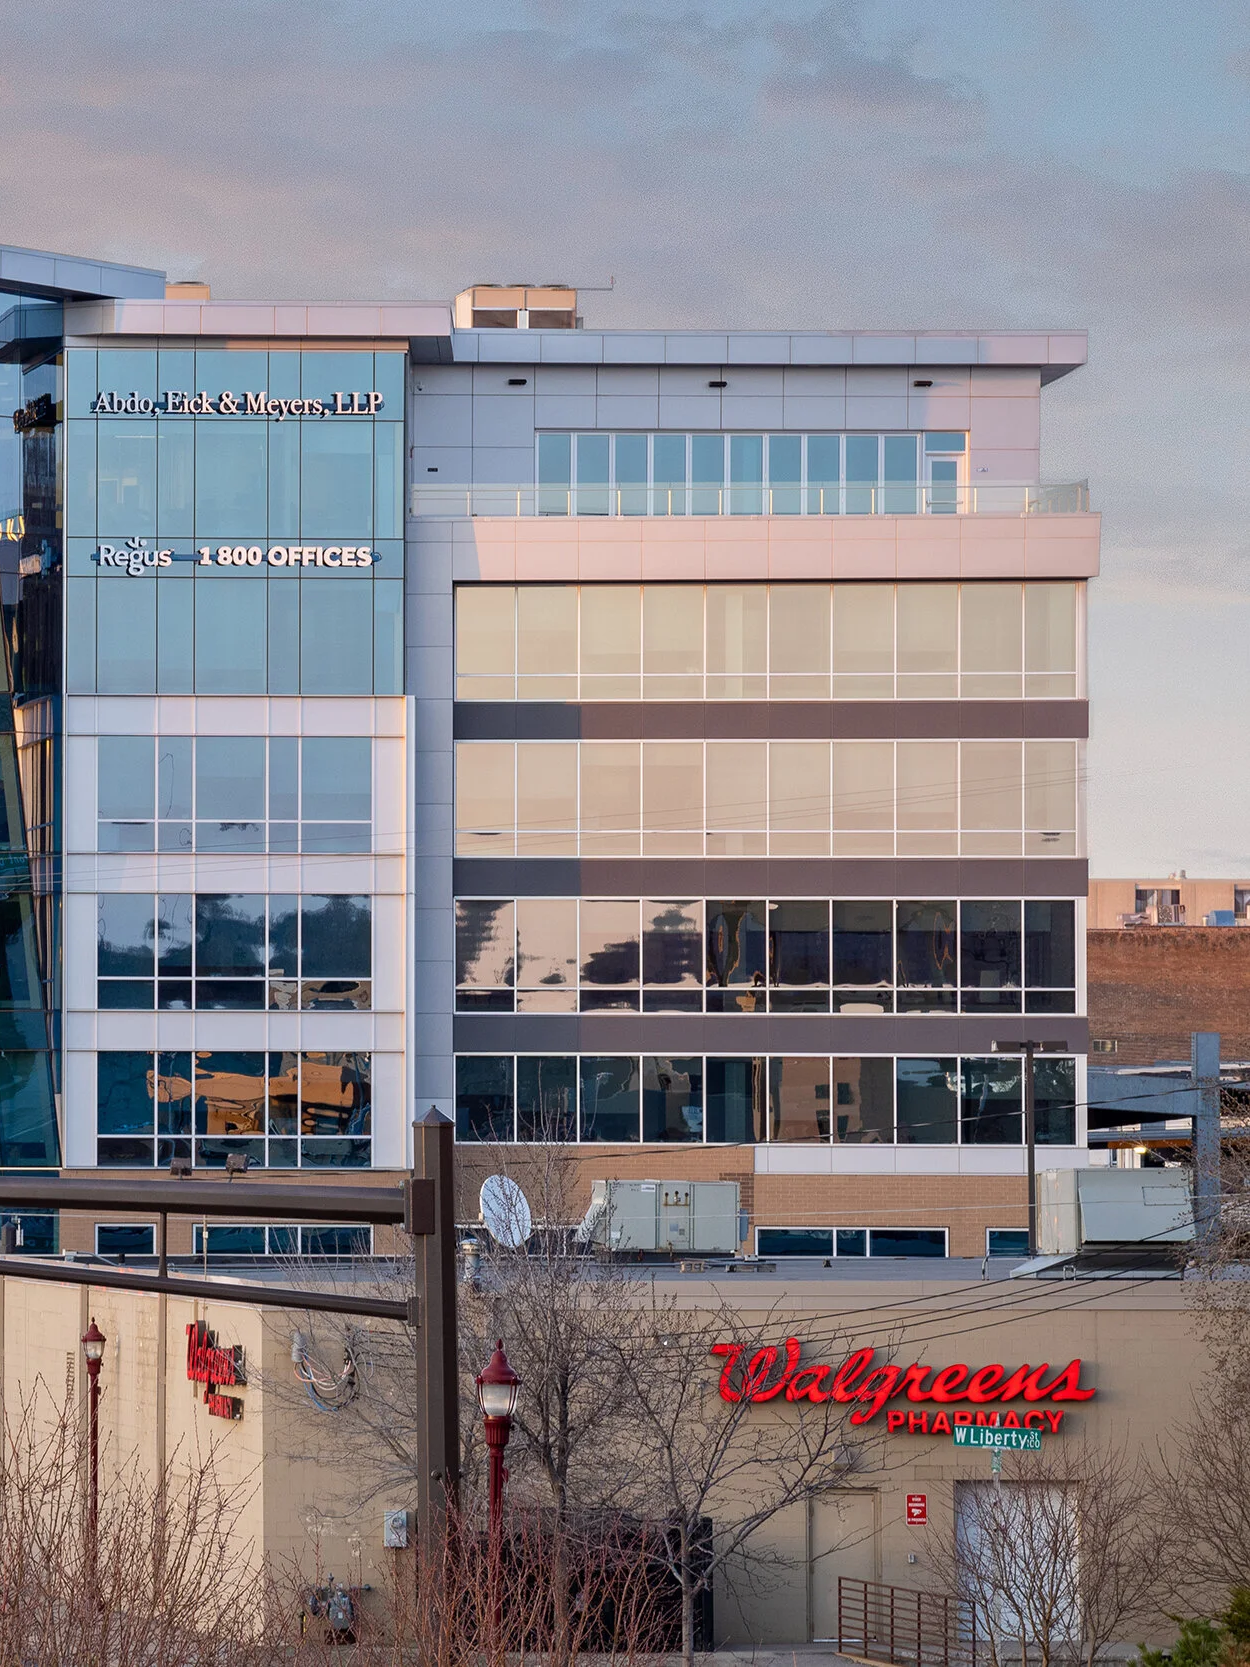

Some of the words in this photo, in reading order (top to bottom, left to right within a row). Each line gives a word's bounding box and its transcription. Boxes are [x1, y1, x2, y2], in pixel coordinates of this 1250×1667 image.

[92, 390, 161, 416] Abdo,
[164, 390, 217, 414] Eick
[218, 390, 240, 414] &
[244, 391, 331, 421] Meyers,
[333, 391, 384, 415] LLP
[100, 543, 173, 576] Regus
[217, 545, 262, 566] 800
[267, 545, 374, 567] OFFICES
[710, 1337, 1096, 1426] Walgreens
[887, 1409, 1065, 1434] PHARMACY
[954, 1427, 967, 1443] W
[970, 1428, 1028, 1450] Liberty
[1029, 1431, 1038, 1440] St
